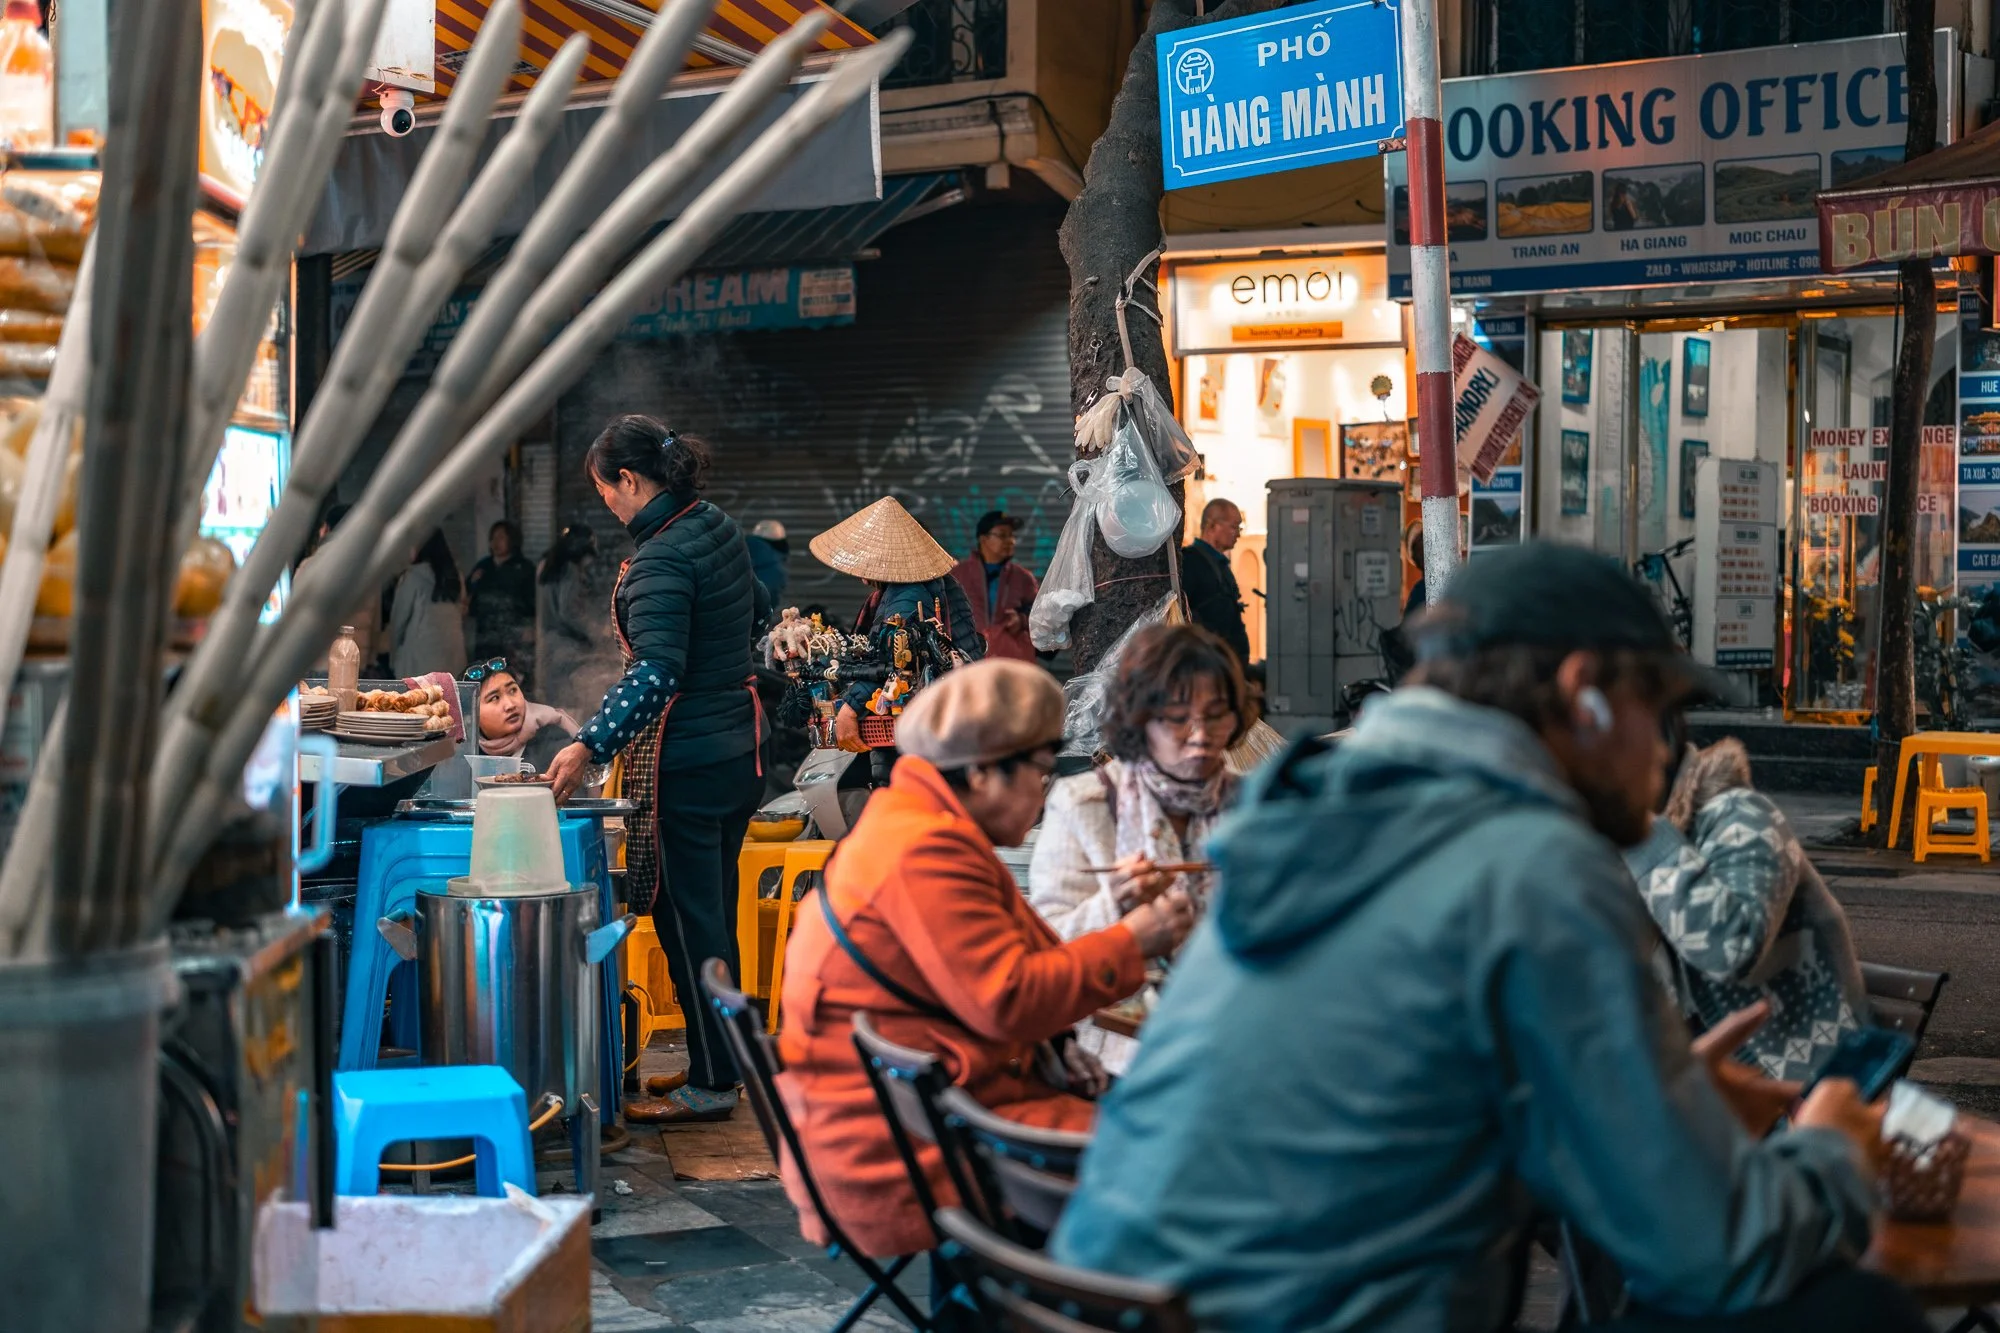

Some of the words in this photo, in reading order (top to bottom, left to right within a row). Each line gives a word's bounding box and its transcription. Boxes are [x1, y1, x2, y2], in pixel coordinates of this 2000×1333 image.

[1257, 17, 1333, 67] PHỐ
[1181, 94, 1271, 158] HÀNG
[1281, 73, 1386, 141] MÀNH
[1447, 87, 1677, 161] OOKING
[1729, 231, 1762, 244] MOC
[1766, 228, 1807, 242] CHAU
[1832, 196, 1961, 268] BÚN
[1512, 245, 1557, 259] TRANG
[1560, 243, 1580, 256] AN
[1620, 239, 1639, 251] HA
[1644, 235, 1687, 249] GIANG
[1646, 264, 1671, 277] ZALO
[1681, 259, 1737, 275] WHATSAPP
[1746, 257, 1790, 272] HOTLINE
[1981, 381, 1998, 393] HUE
[1457, 367, 1497, 442] AUNDRY
[1813, 429, 1867, 447] MONEY
[1872, 428, 1954, 445] EXNGE
[1963, 467, 1972, 480] TA
[1811, 497, 1877, 513] BOOKING
[1972, 553, 1989, 567] CAT
